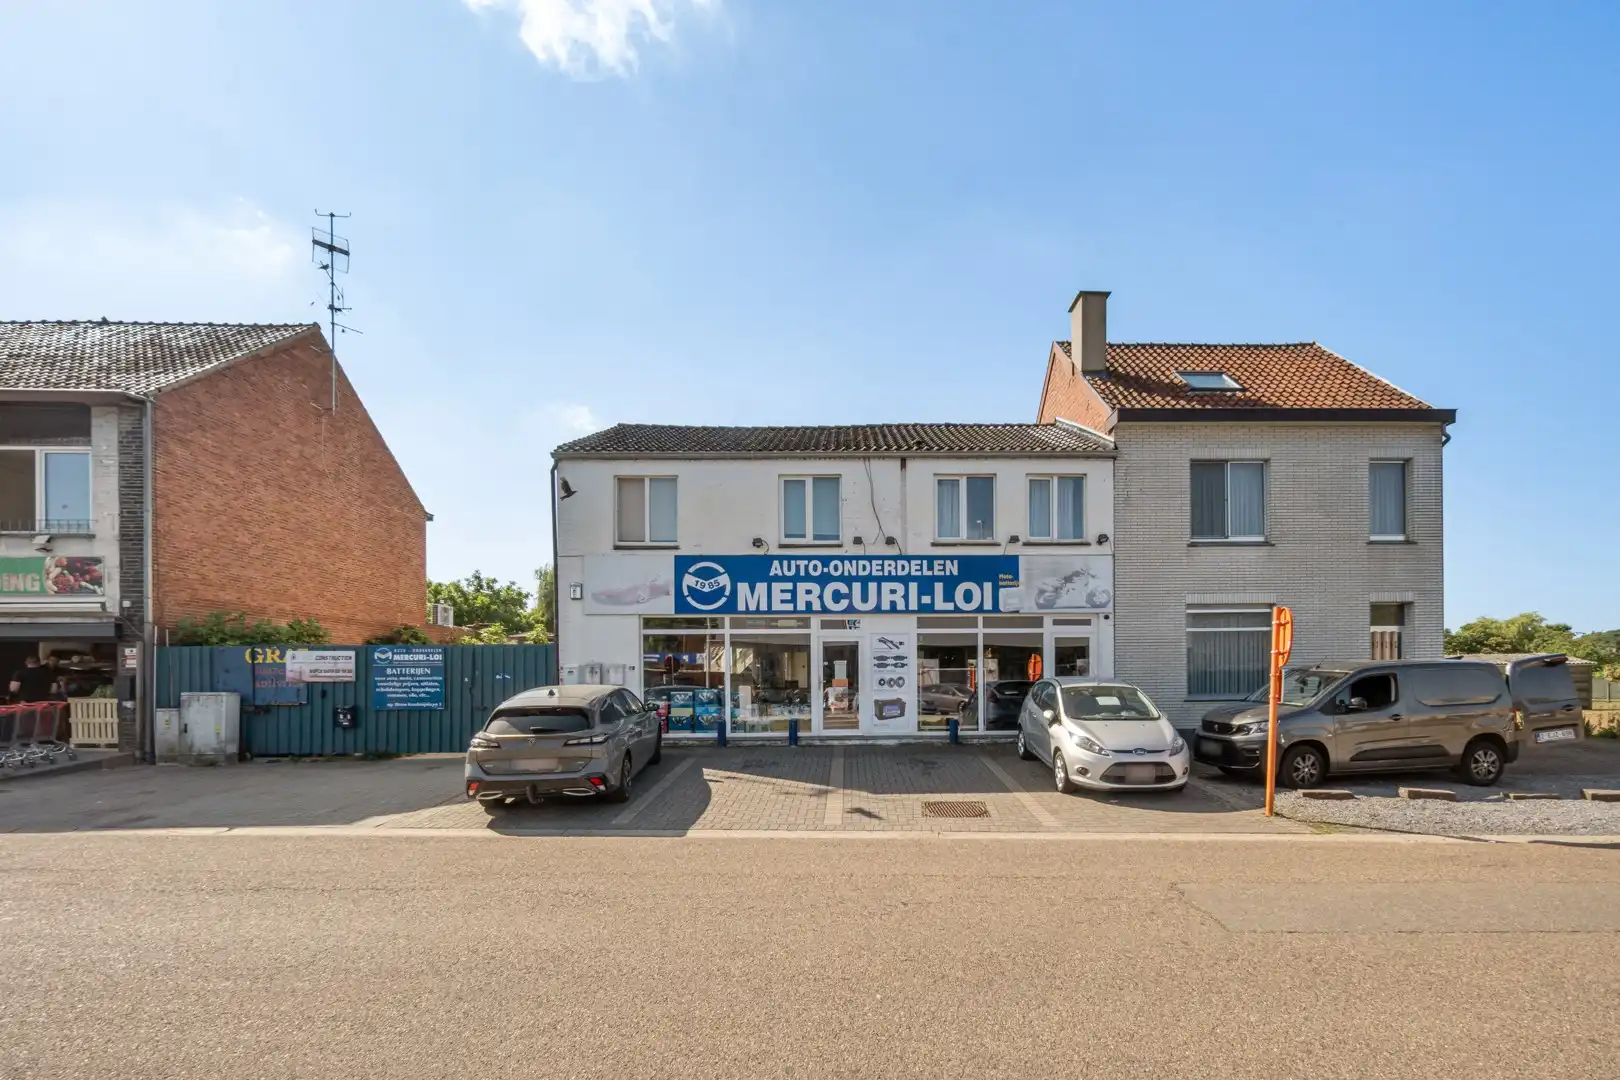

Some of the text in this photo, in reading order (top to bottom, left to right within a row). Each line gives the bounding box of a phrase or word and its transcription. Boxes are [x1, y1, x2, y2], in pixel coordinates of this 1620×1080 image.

[769, 560, 959, 577] AUTO-ONDERDELEN
[0, 573, 41, 592] ING
[737, 582, 993, 611] MERCURI-LOI
